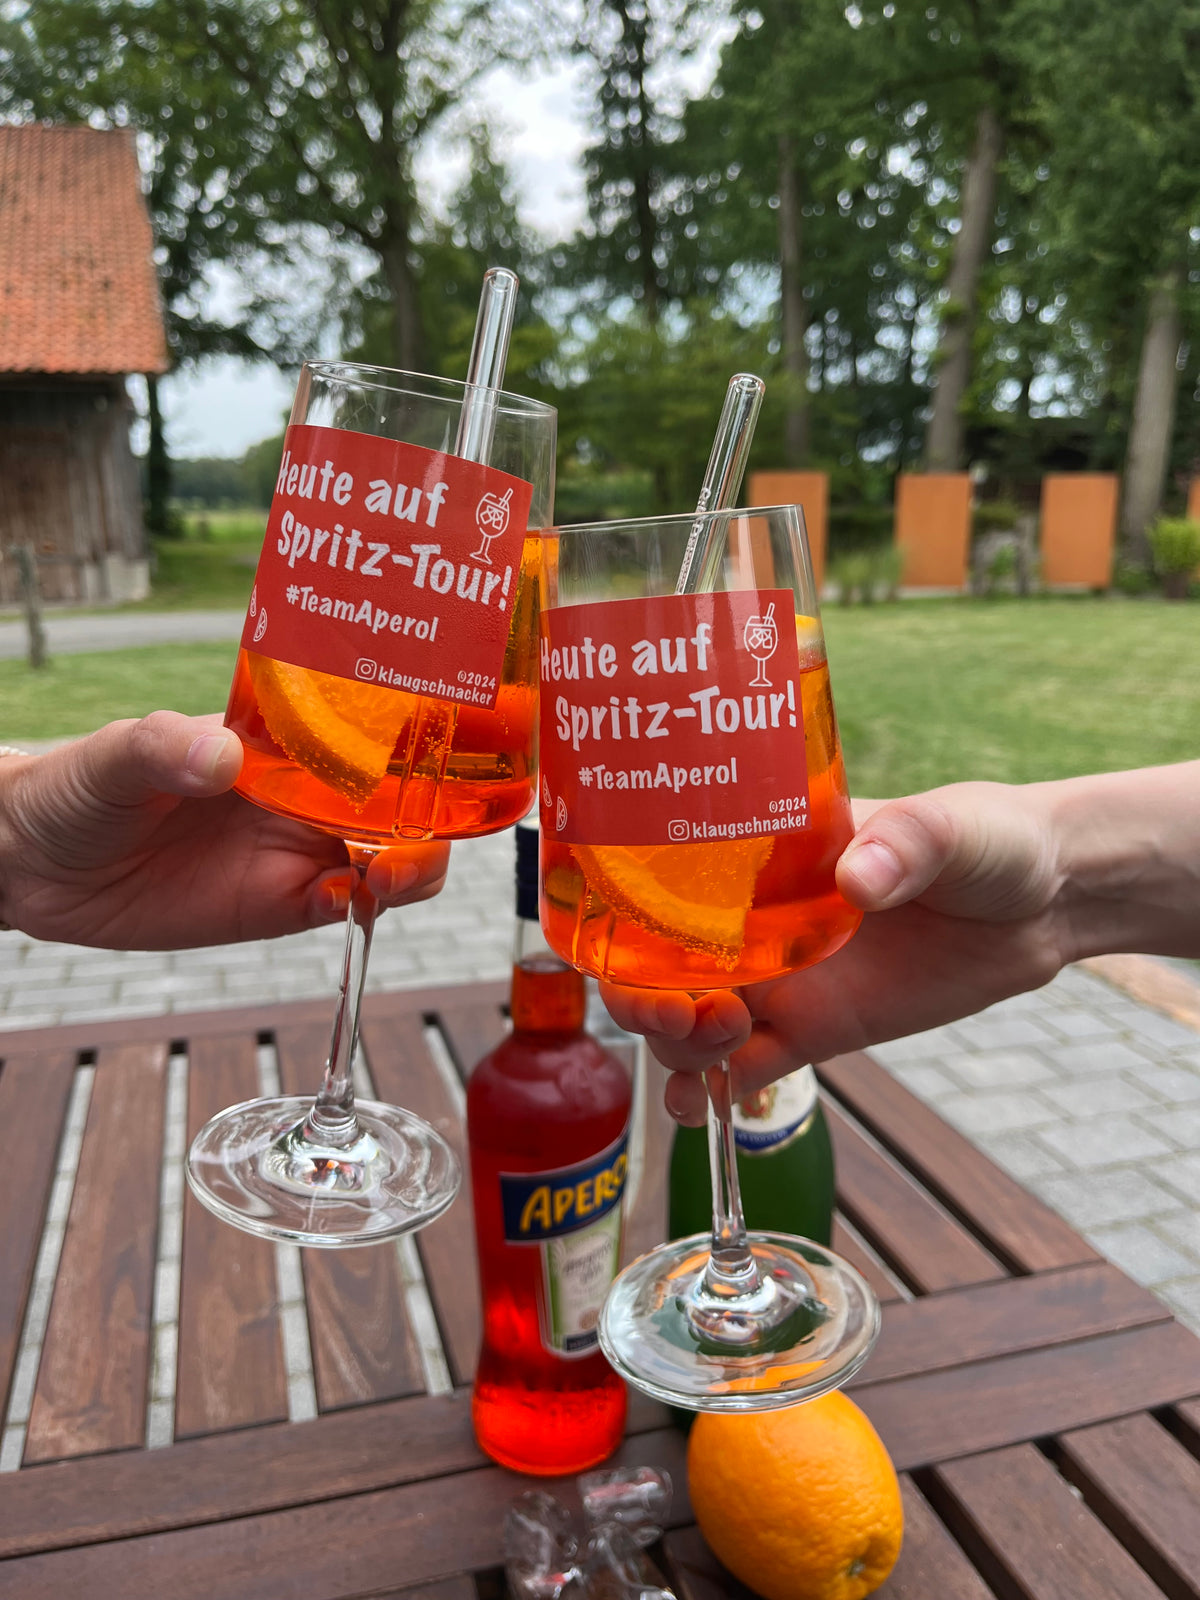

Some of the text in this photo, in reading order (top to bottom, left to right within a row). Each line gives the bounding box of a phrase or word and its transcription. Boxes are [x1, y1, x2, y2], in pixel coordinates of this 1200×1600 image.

[276, 450, 449, 528] Heute auf
[277, 510, 513, 612] Spritz-Tour!
[286, 584, 439, 642] #TeamAperol
[457, 669, 496, 689] ©2024
[540, 622, 712, 683] Heute auf
[378, 665, 493, 707] klaugschnacker
[555, 680, 797, 751] Spritz-Tour!
[578, 757, 738, 793] #TeamAperol
[692, 812, 808, 840] klaugschnacker
[768, 796, 807, 814] ©2024
[520, 1153, 628, 1233] APERO
